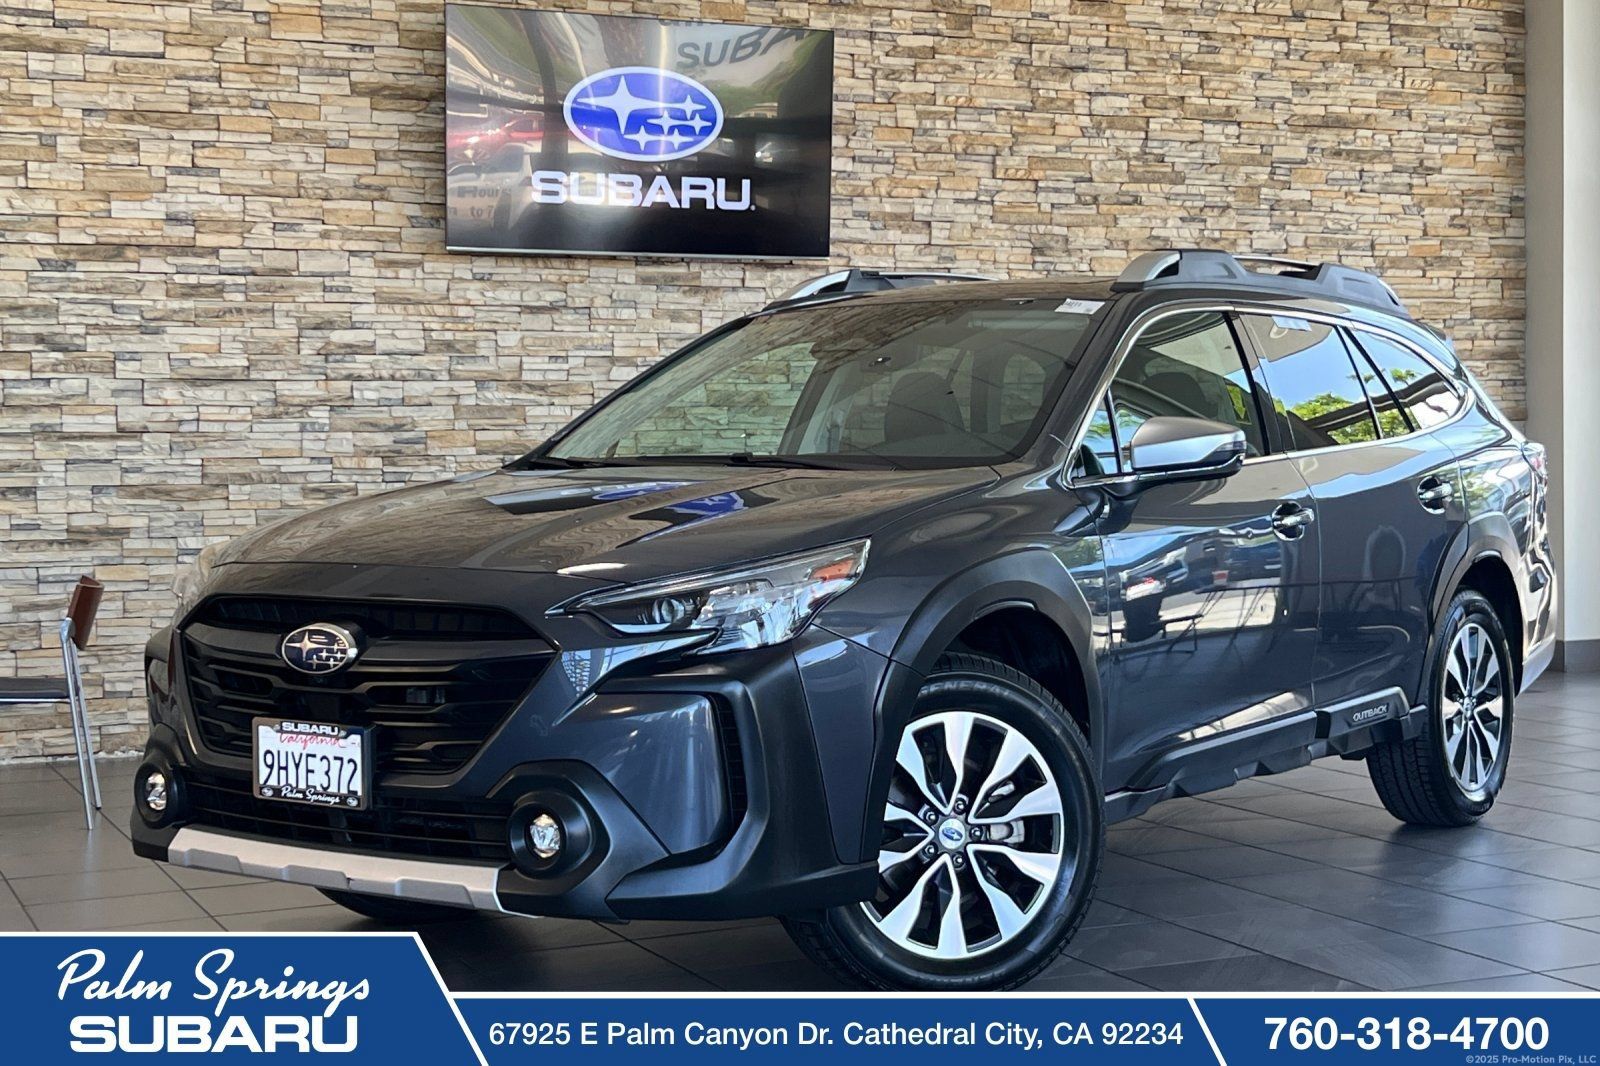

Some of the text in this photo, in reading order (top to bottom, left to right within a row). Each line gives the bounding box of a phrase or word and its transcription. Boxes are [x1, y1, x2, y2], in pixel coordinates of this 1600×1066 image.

[1353, 705, 1387, 721] OUTBACK
[281, 722, 338, 735] SUBARU
[263, 749, 359, 796] 9HYE372
[281, 785, 340, 805] Palm Springs
